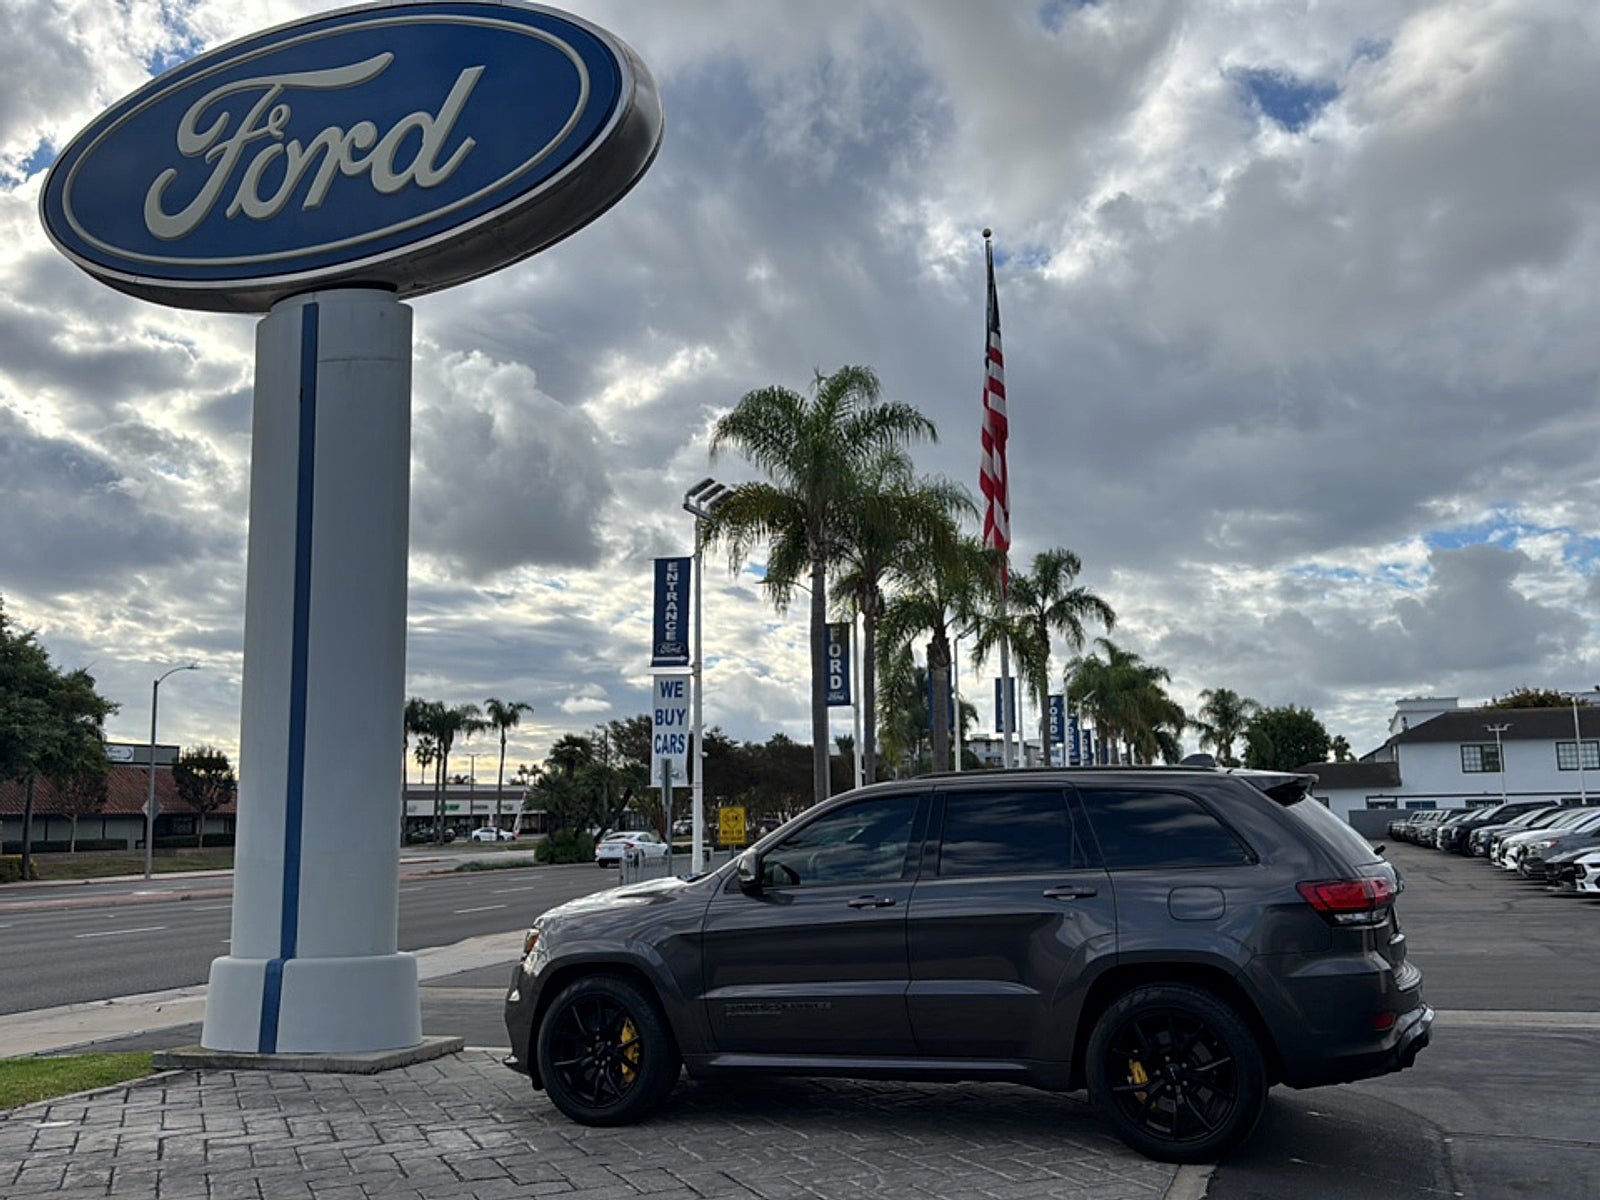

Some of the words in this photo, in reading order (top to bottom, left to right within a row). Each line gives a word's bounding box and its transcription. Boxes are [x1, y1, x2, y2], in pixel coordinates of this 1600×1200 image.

[144, 52, 485, 240] Ford
[665, 562, 678, 641] ENTRANCE
[828, 627, 842, 690] FORD
[660, 681, 684, 698] WE
[655, 708, 686, 726] BUY
[655, 733, 685, 754] CARS
